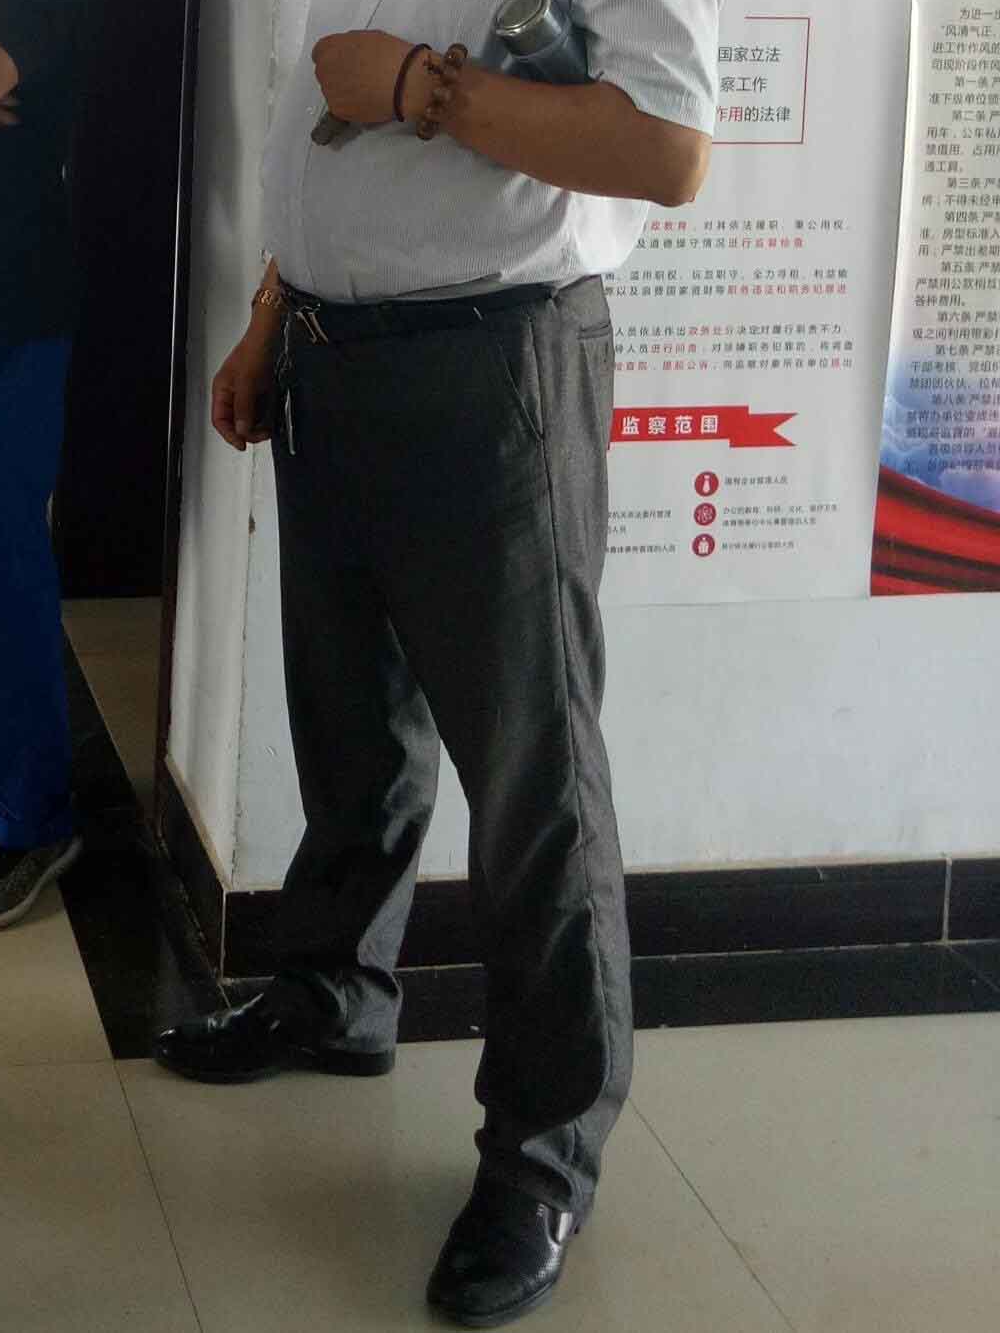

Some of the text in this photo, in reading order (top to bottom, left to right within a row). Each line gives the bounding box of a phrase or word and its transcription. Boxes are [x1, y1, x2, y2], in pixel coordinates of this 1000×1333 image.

[718, 46, 782, 63] 国家立法
[720, 76, 768, 93] 察工作
[621, 414, 719, 435] 监察范围
